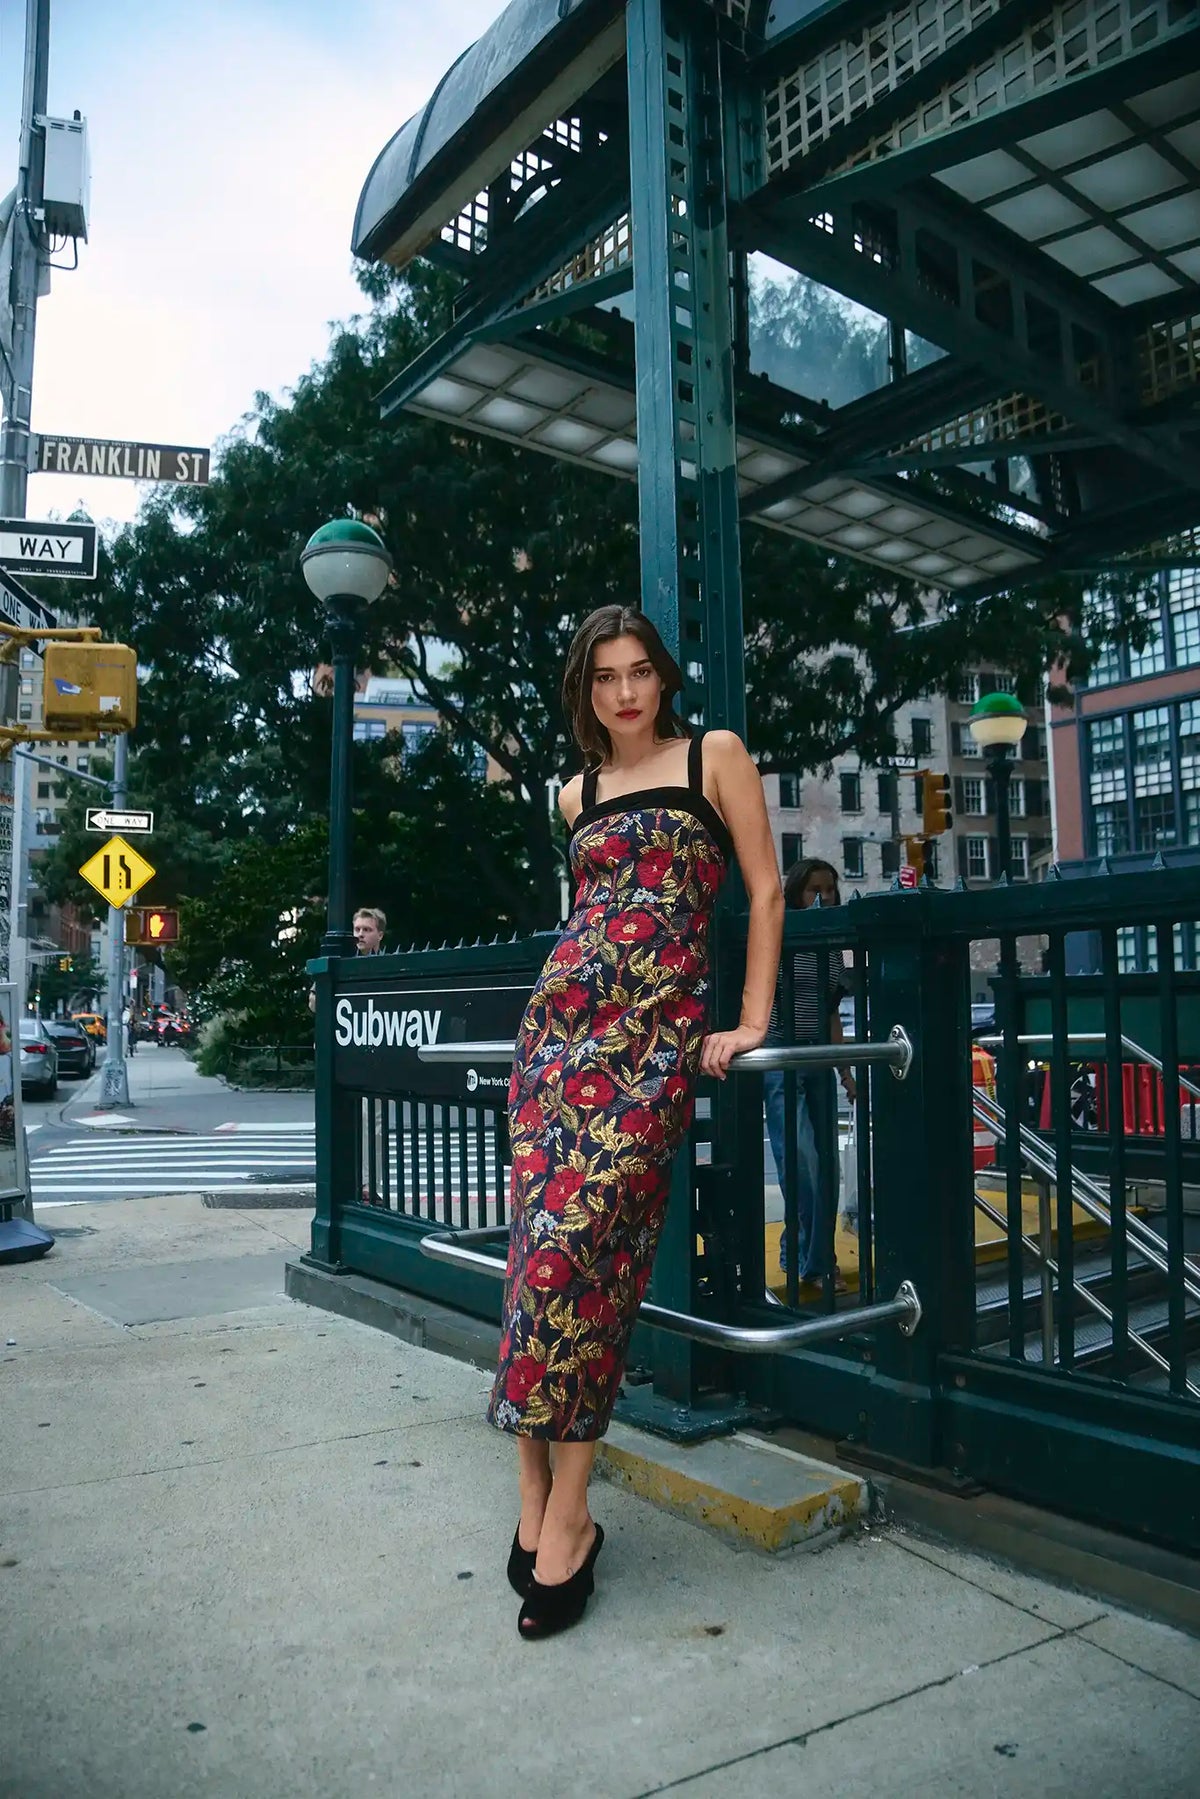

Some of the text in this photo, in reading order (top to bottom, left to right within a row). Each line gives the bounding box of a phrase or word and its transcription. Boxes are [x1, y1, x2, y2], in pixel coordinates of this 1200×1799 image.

[42, 441, 204, 482] FRANKLIN ST
[19, 537, 72, 559] WAY
[3, 590, 22, 624] ONE
[97, 816, 143, 826] ONE WAY
[335, 998, 441, 1048] Subway
[479, 1076, 491, 1086] New
[491, 1077, 504, 1087] York
